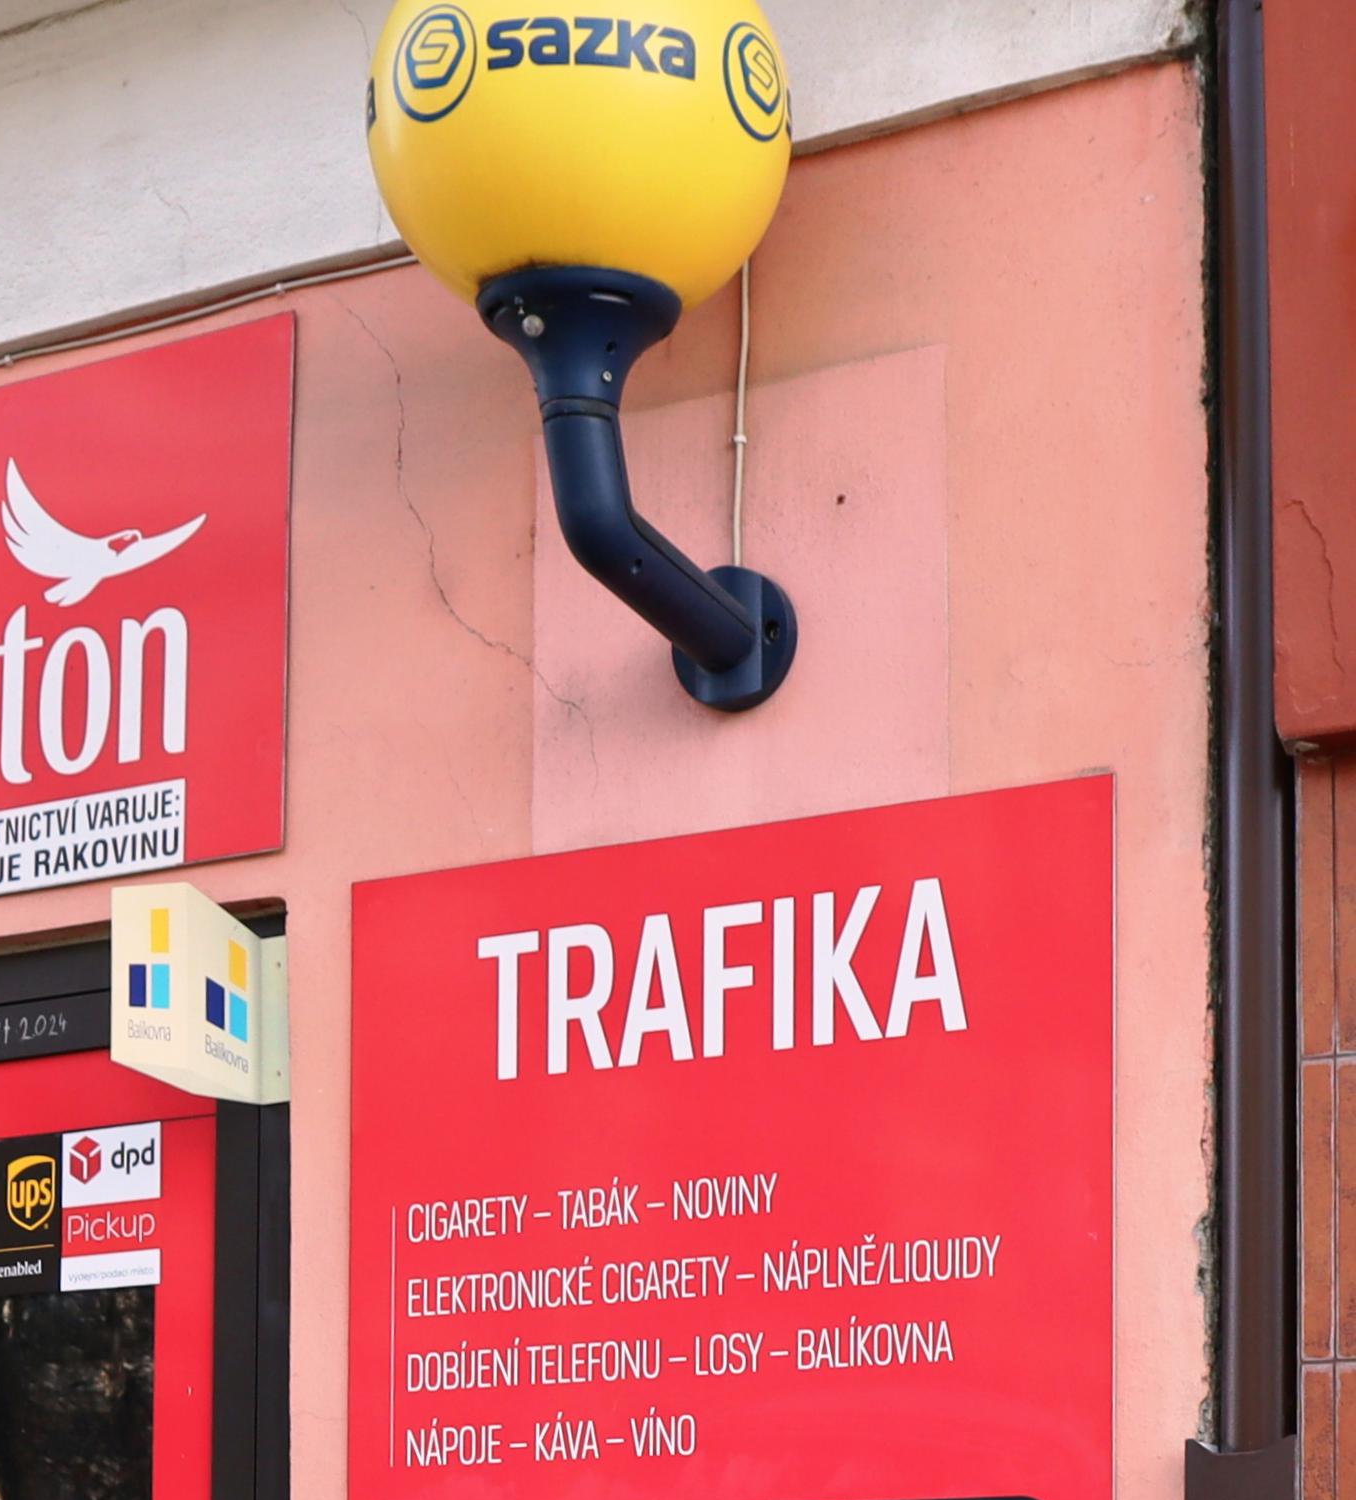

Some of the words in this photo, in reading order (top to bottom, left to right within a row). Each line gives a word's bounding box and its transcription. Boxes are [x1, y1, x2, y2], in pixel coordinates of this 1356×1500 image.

[86, 792, 181, 831] VARUJE:
[34, 826, 180, 878] RAKOVINU
[477, 877, 968, 1080] TRAFIKA
[111, 1137, 156, 1175] dpd
[11, 1176, 53, 1219] ups
[407, 1194, 529, 1243] CIGARETY
[558, 1177, 639, 1231] TABÁK
[672, 1172, 778, 1221] NOVINY
[67, 1210, 157, 1243] Pickup
[408, 1257, 593, 1319] ELEKTRONICKÉ
[601, 1254, 730, 1306] CIGARETY
[762, 1234, 1002, 1293] NÁPLNĚ/LIQUIDY
[407, 1337, 520, 1393] DOBÍJENÍ
[527, 1338, 662, 1386] TELEFONU
[694, 1331, 764, 1377] LOSY
[796, 1316, 954, 1371] BALÍKOVNA
[406, 1411, 502, 1468] NÁPOJE
[534, 1411, 600, 1462] KÁVA
[630, 1406, 698, 1457] VÍNO
